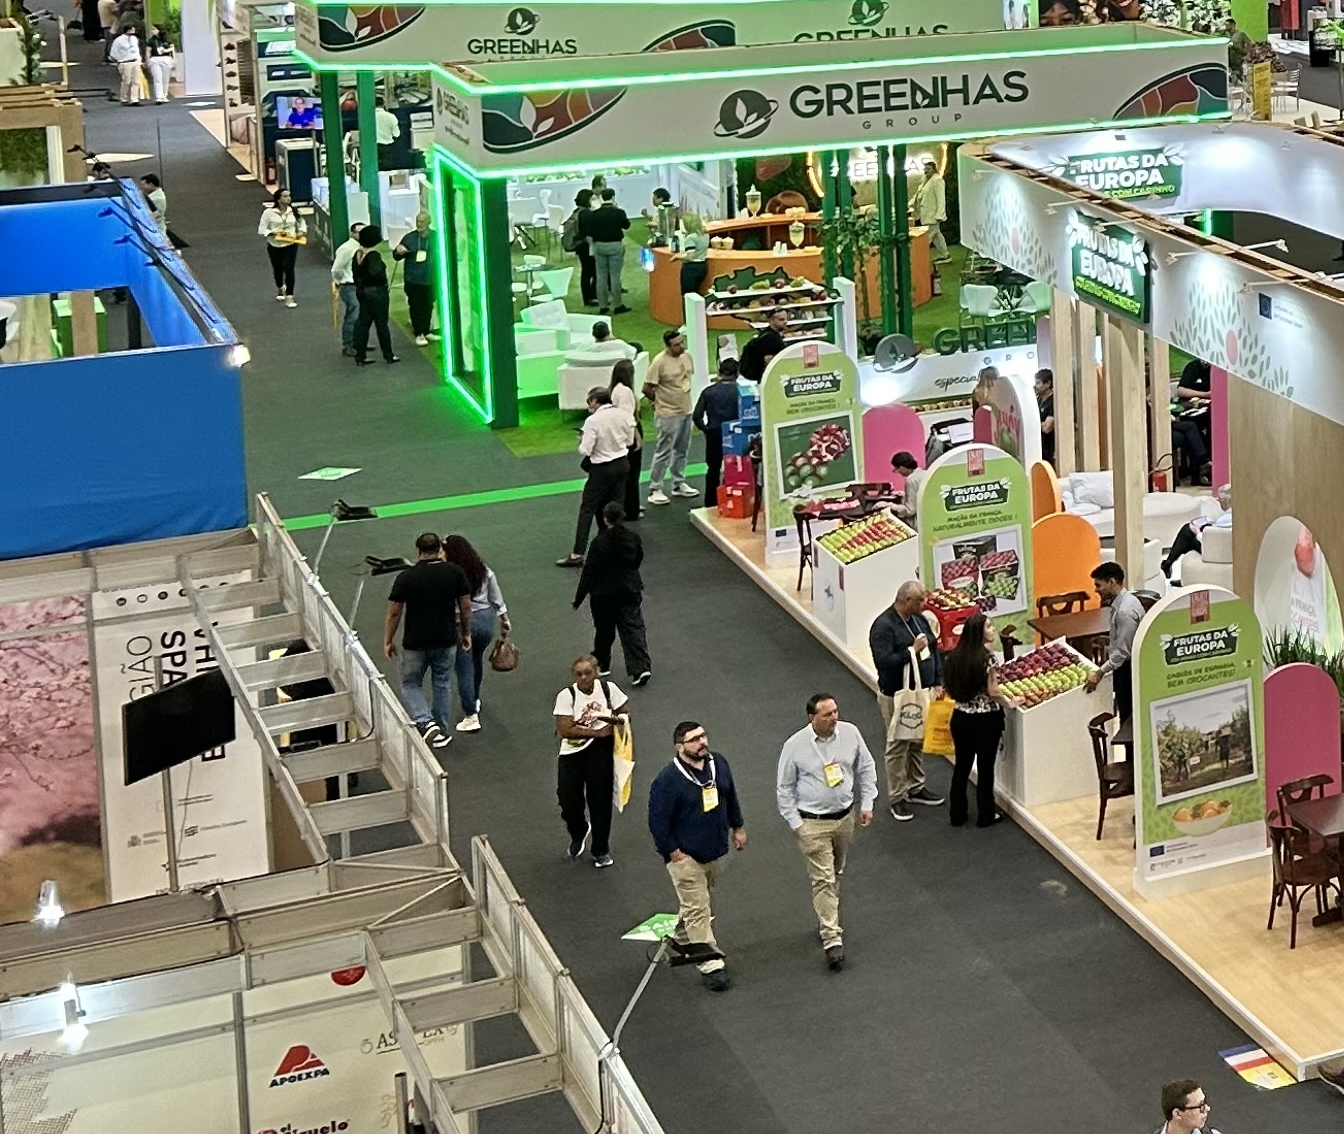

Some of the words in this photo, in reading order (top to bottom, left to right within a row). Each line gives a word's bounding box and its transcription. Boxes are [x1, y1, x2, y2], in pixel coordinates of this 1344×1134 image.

[467, 38, 578, 56] GREENHAS
[789, 70, 1030, 119] GREENHAS
[862, 113, 963, 130] GROUP
[1142, 150, 1169, 168] DA
[1075, 168, 1165, 191] EUROPA
[1080, 250, 1135, 297] EUROPA
[792, 381, 833, 394] EUROPA
[951, 486, 986, 497] FRUTAS
[986, 482, 1001, 492] DA
[954, 490, 999, 505] EUROPA
[1173, 632, 1212, 647] FRUTAS
[1213, 629, 1229, 640] DA
[1175, 639, 1227, 657] EUROPA
[1167, 678, 1185, 689] BEM
[268, 1067, 331, 1089] APOEXPA
